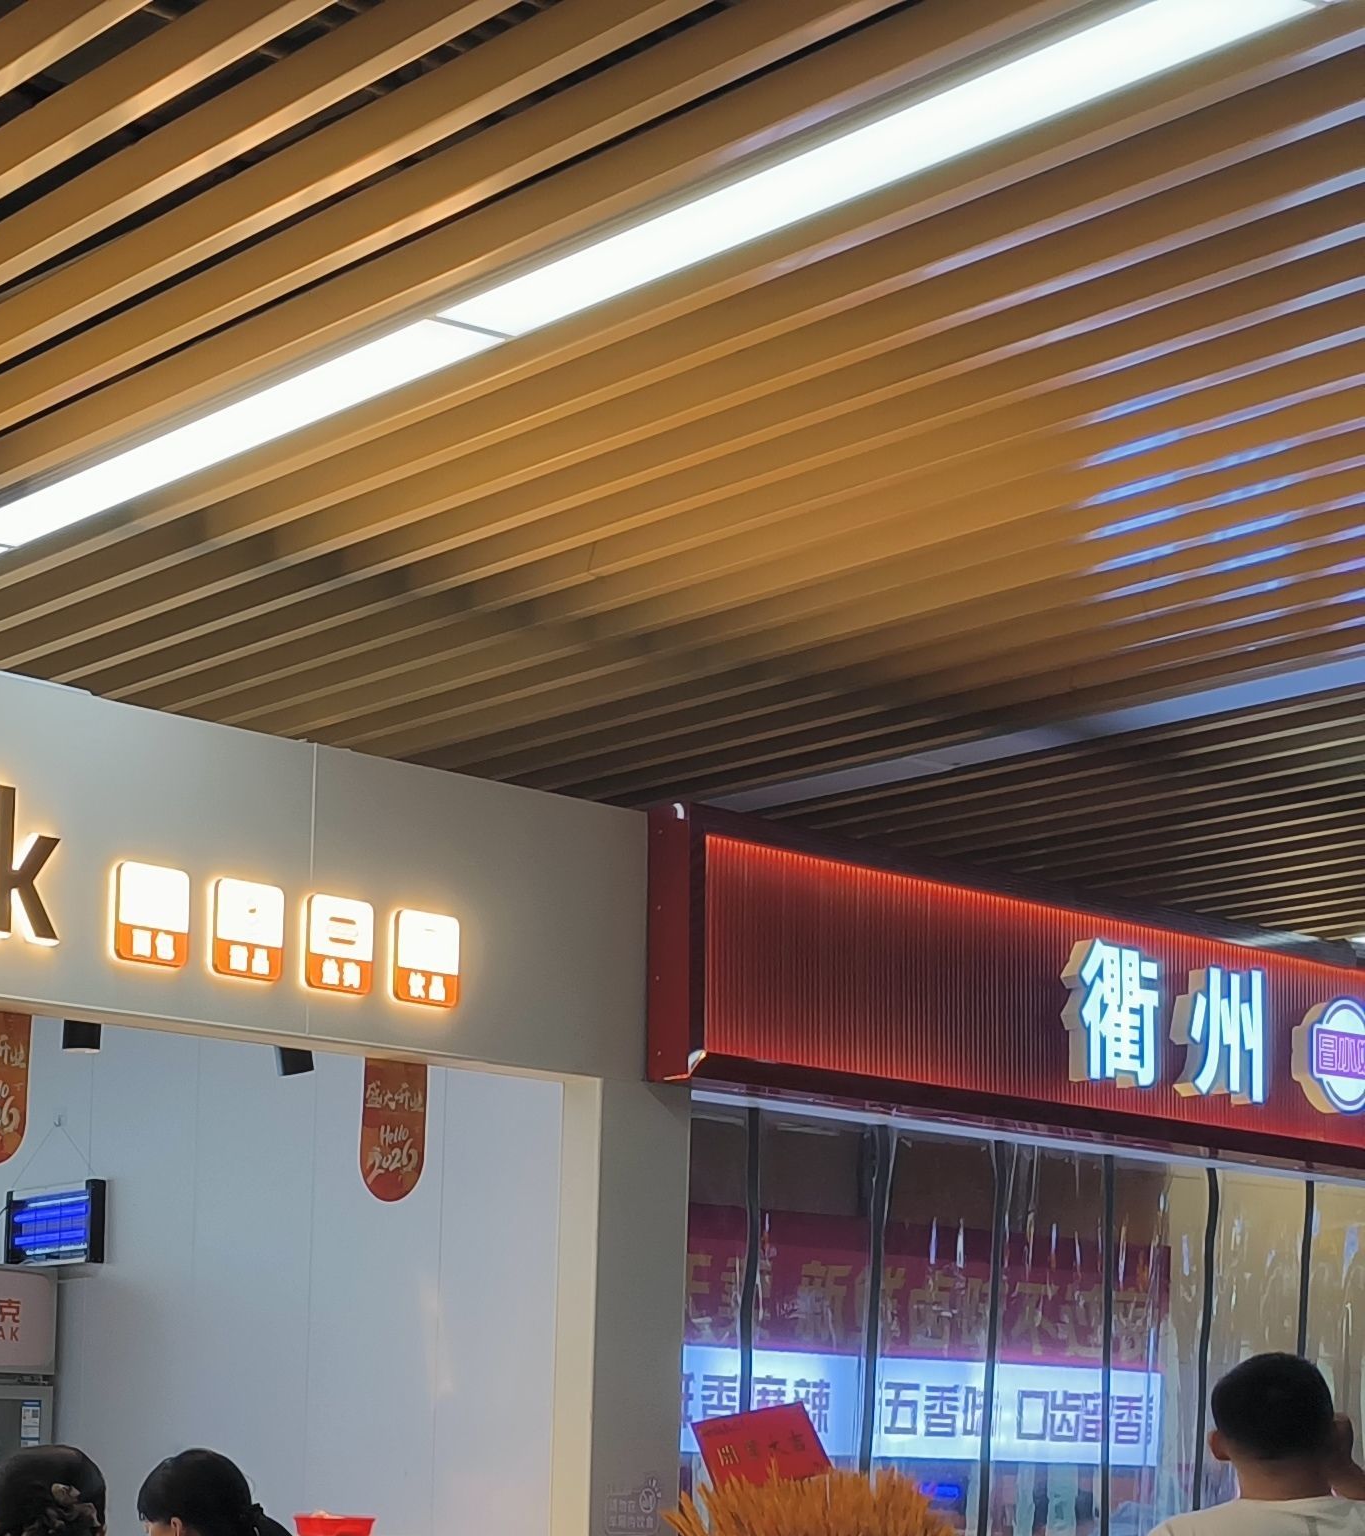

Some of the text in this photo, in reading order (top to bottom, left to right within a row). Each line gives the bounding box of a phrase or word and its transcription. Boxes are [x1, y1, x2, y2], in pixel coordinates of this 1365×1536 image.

[1080, 938, 1265, 1104] 衢州
[380, 1124, 409, 1145] Hello
[366, 1138, 419, 1185] 2026
